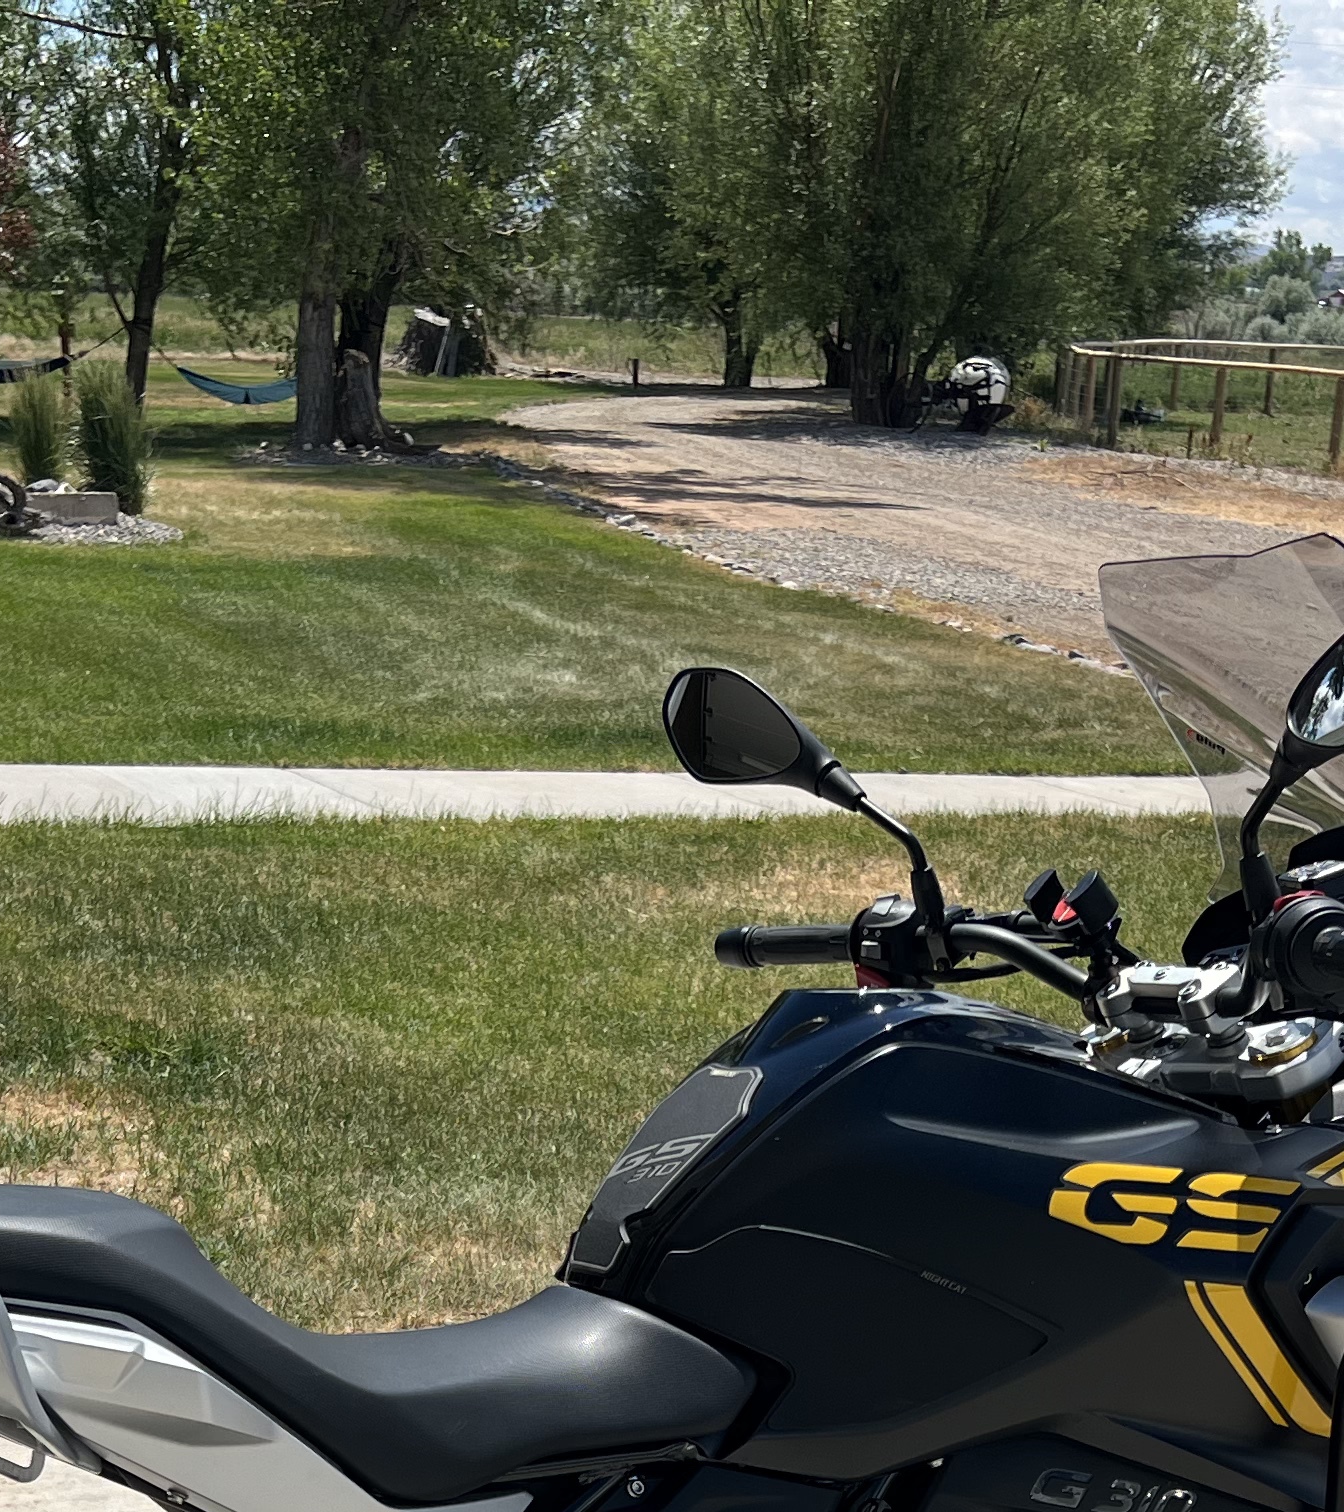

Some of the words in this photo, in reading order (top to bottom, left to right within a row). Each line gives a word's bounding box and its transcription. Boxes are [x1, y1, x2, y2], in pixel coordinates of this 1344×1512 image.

[605, 1132, 718, 1180] GS
[627, 1160, 682, 1184] 310
[1047, 1161, 1302, 1254] GS
[1029, 1468, 1093, 1509] G
